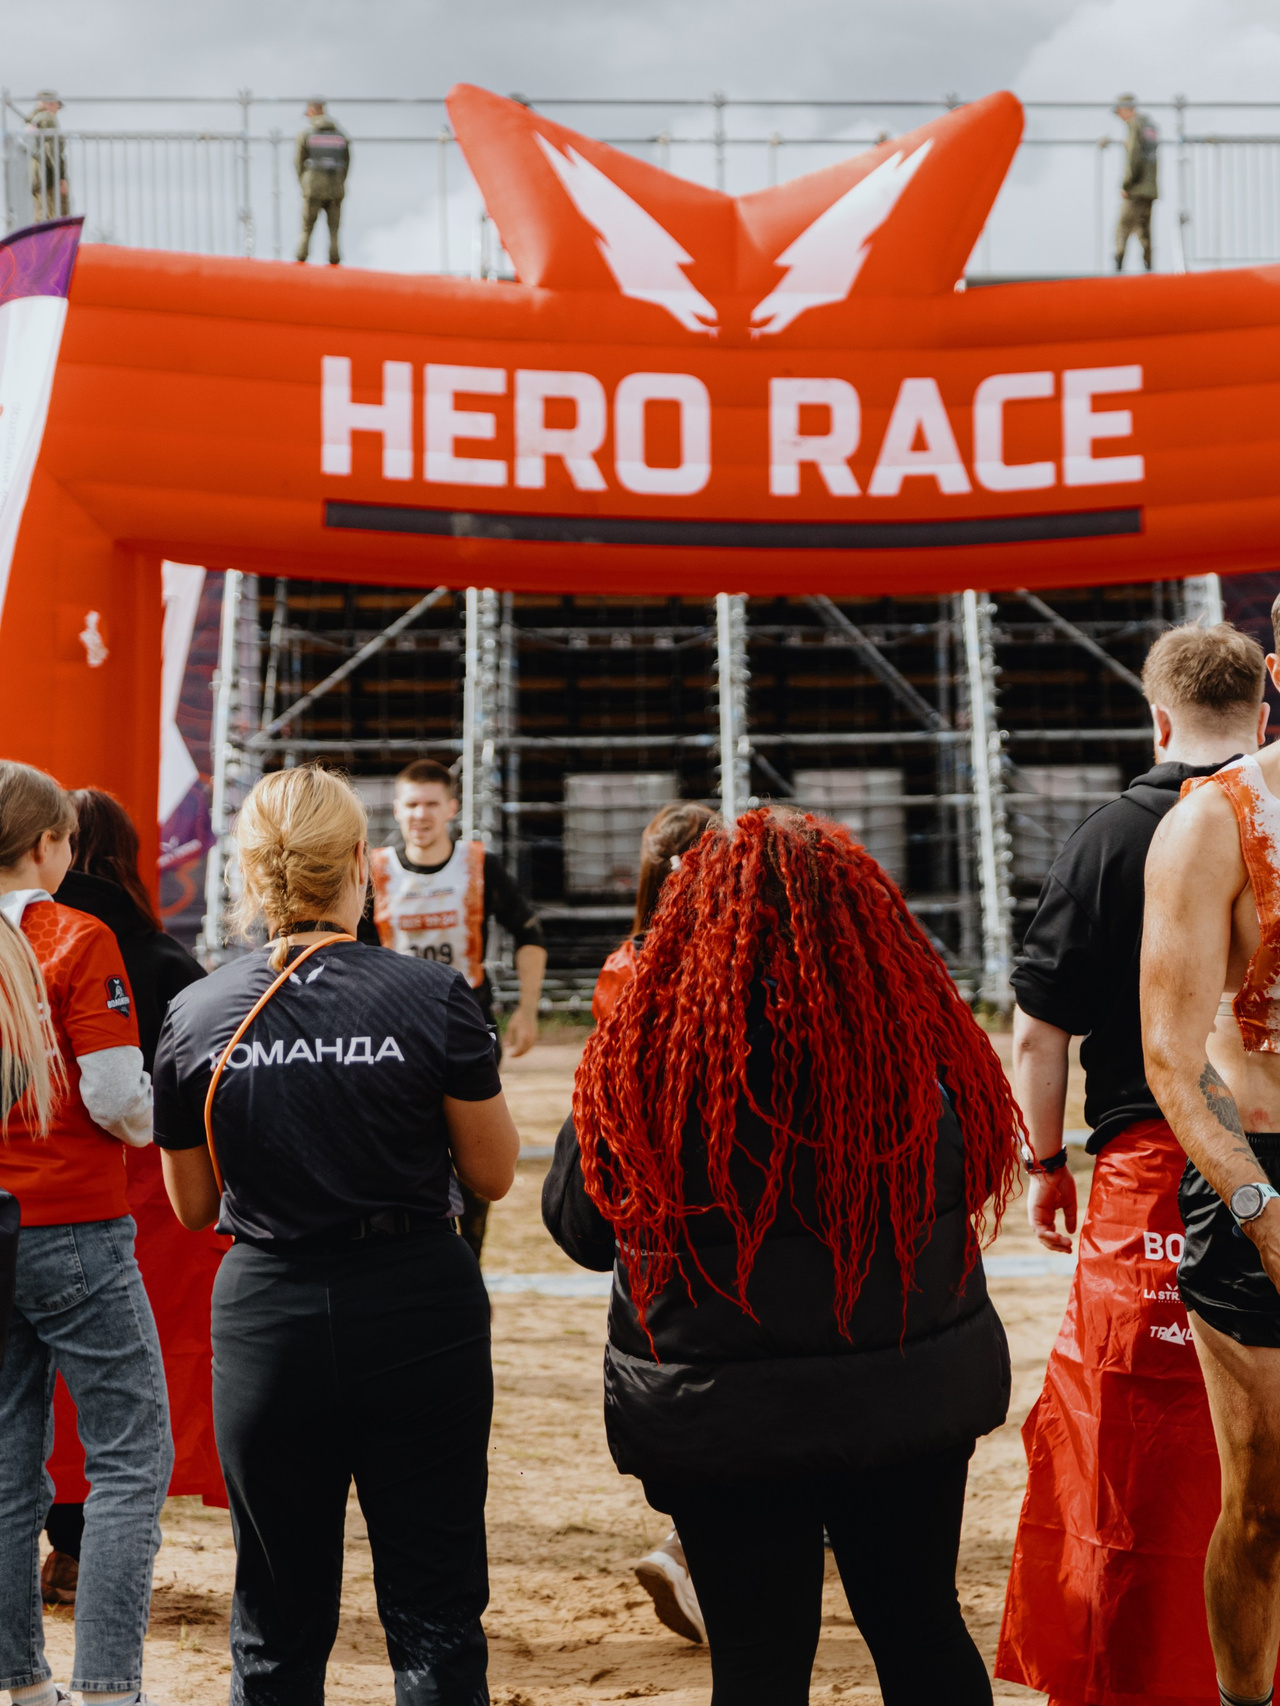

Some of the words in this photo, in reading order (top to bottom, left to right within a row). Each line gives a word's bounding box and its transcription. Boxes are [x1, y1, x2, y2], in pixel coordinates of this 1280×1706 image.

[320, 354, 712, 497] HERO
[768, 364, 1146, 498] RACE
[1143, 1288, 1157, 1300] LA
